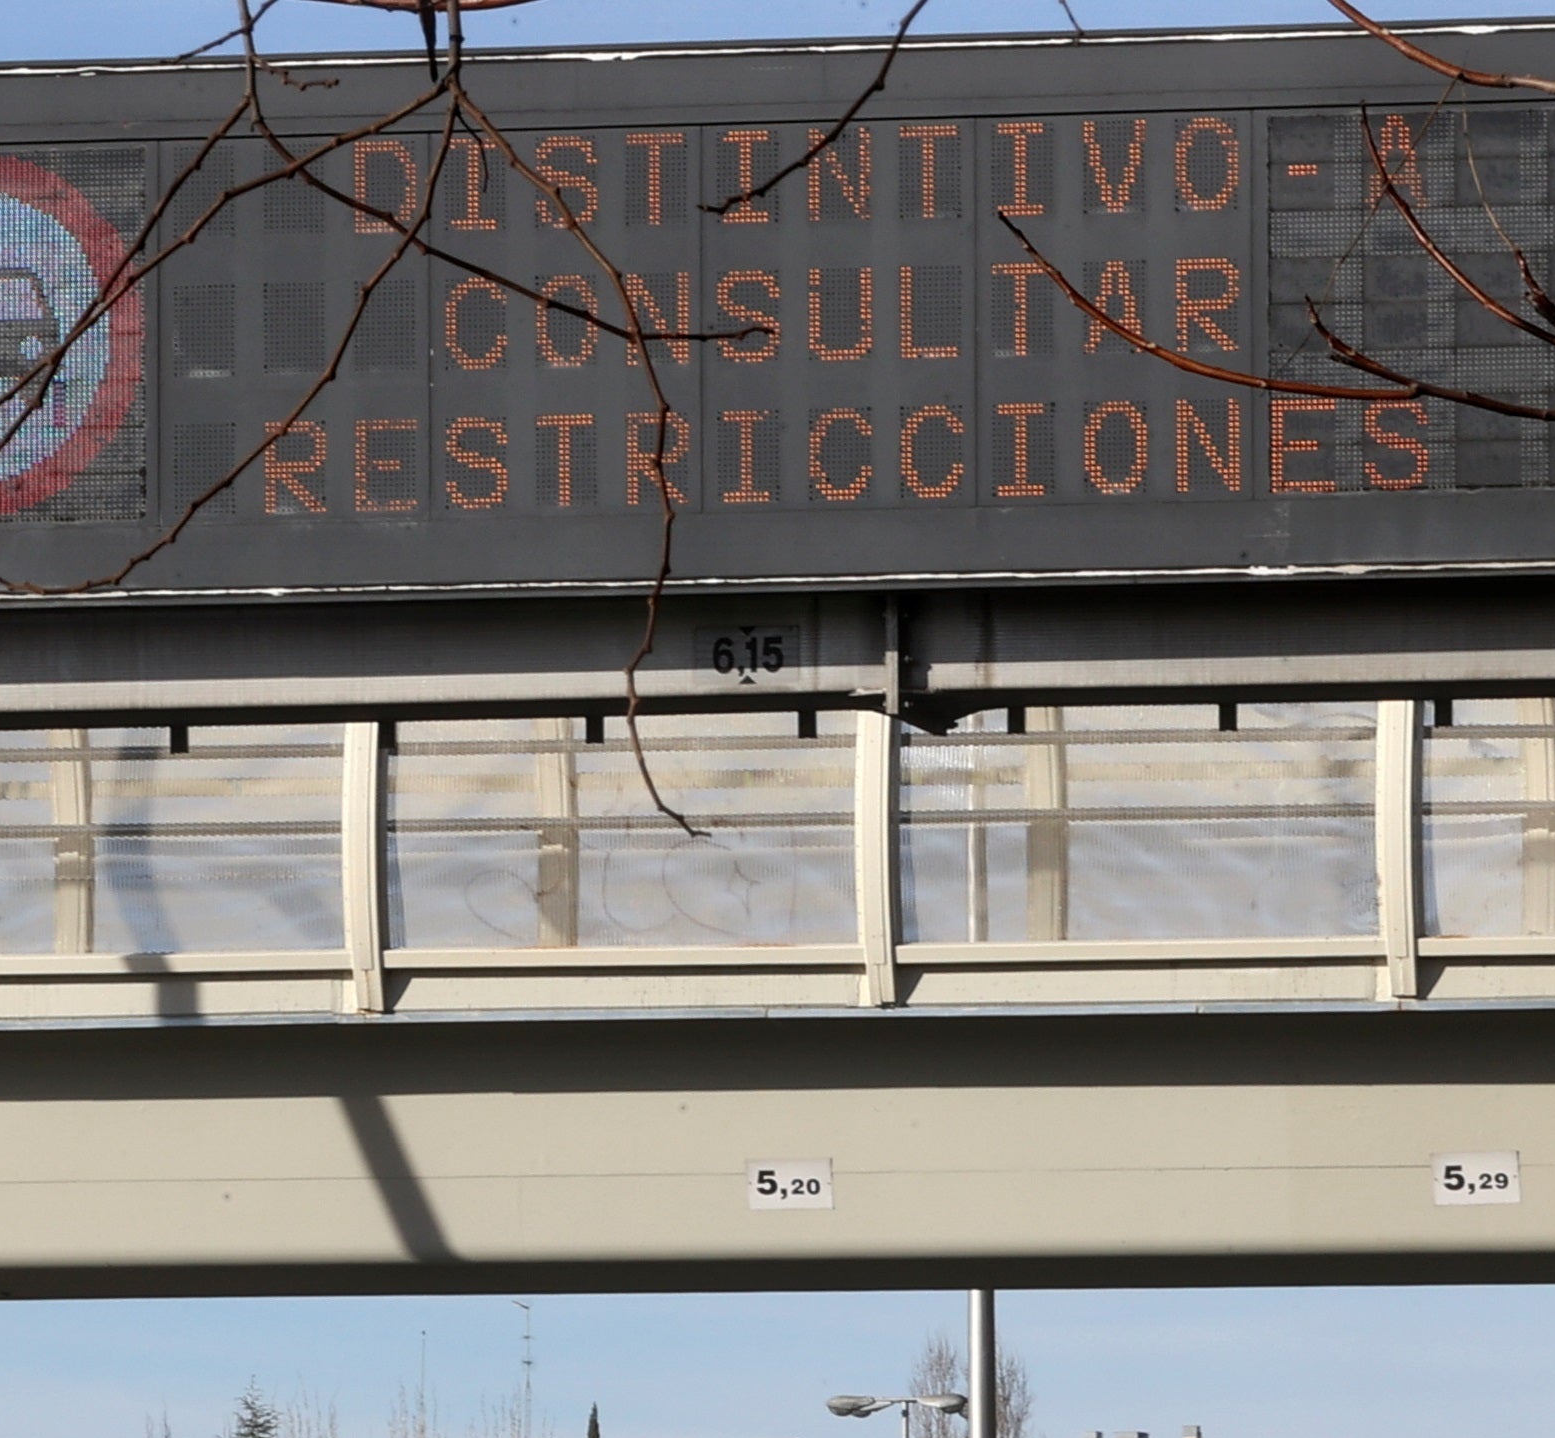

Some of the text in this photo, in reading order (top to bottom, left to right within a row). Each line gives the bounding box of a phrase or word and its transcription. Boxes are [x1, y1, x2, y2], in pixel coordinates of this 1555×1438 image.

[445, 257, 1240, 371] CONSULTAR
[263, 398, 1430, 514] RESTRICCIONES
[712, 635, 784, 677] 6,15
[756, 1169, 821, 1200] 5,20
[1443, 1164, 1510, 1195] 5,29
